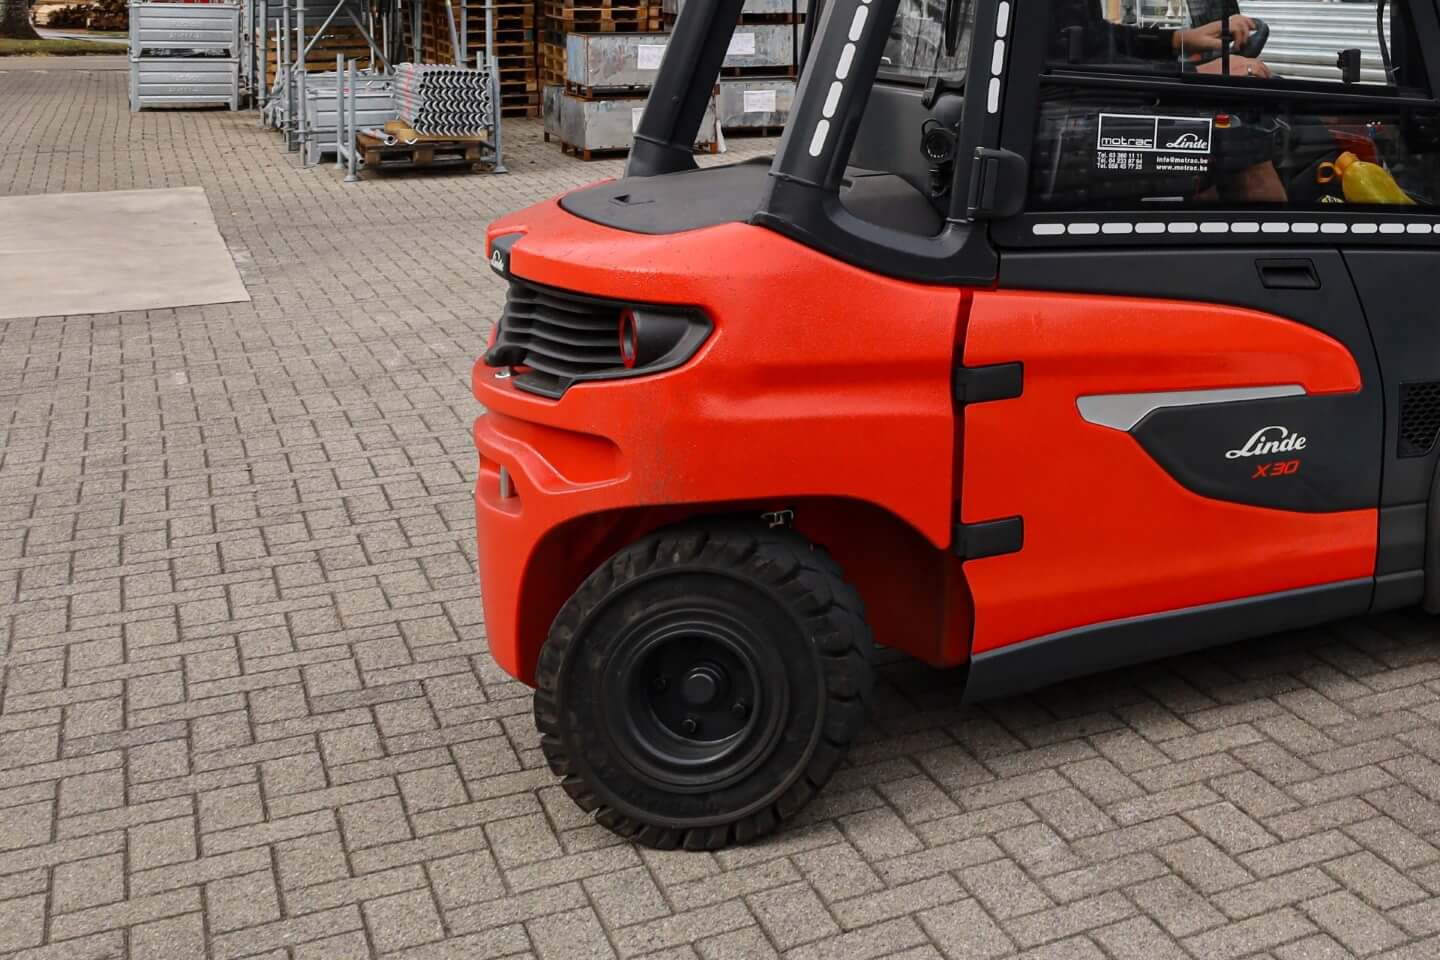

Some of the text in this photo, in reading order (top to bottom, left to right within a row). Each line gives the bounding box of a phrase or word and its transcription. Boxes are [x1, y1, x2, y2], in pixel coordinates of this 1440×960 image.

[1101, 136, 1153, 147] motrac
[1166, 133, 1208, 149] Linde
[1225, 425, 1307, 459] Linde
[1250, 458, 1301, 480] X30
